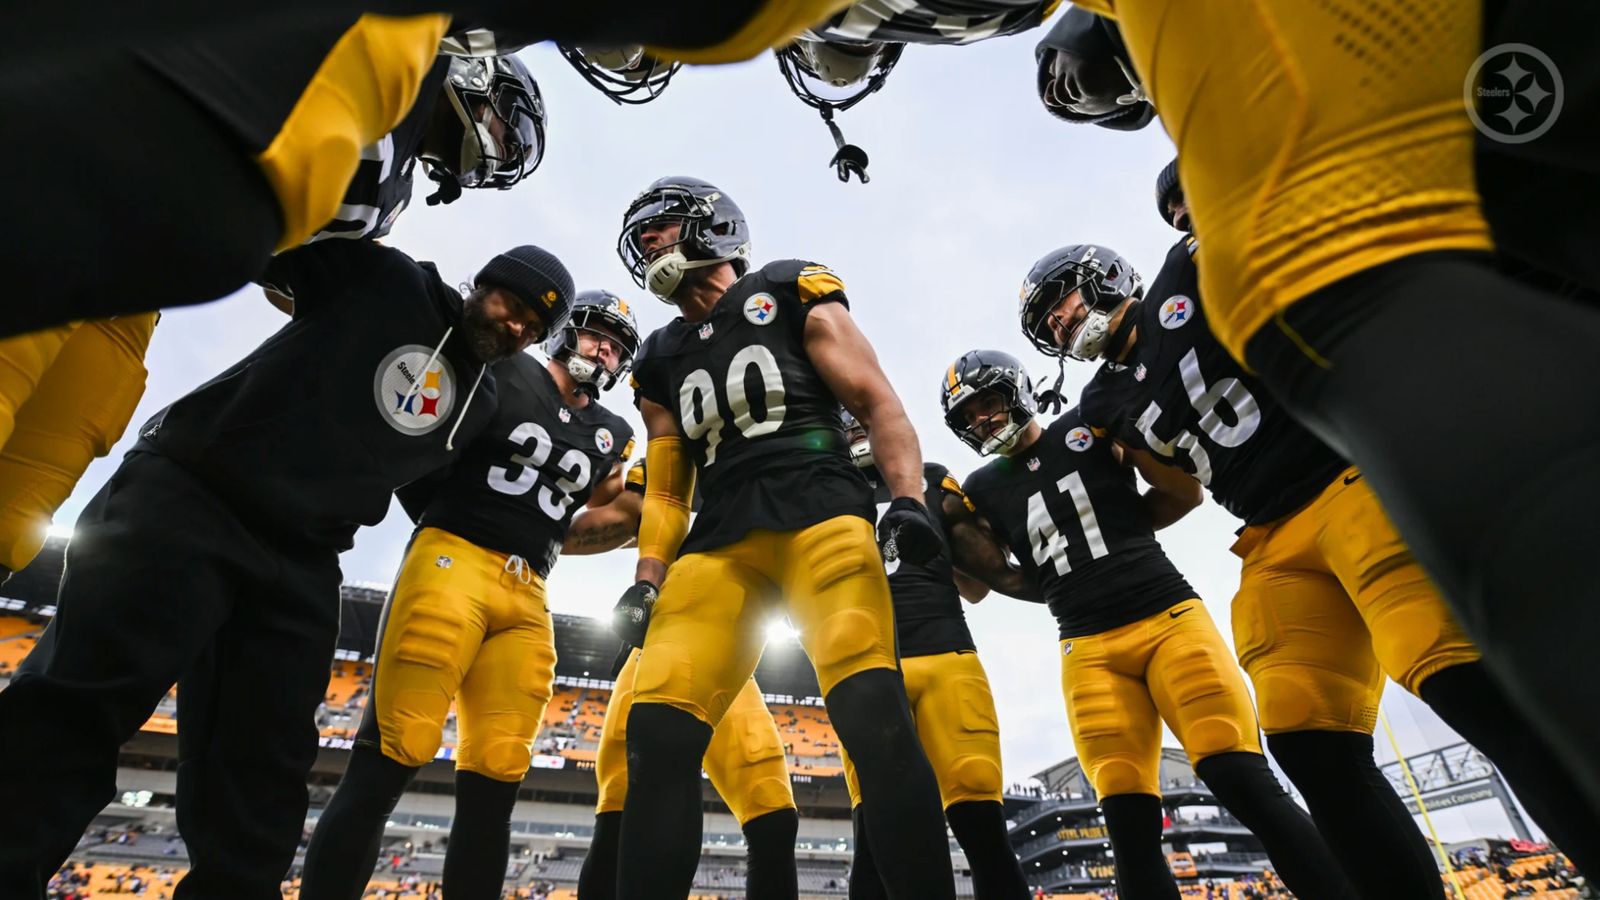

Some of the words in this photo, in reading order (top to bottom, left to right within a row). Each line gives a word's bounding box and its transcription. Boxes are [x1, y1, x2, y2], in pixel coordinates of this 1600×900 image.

[397, 361, 420, 390] Steeles
[678, 343, 787, 468] 90
[1134, 346, 1262, 488] 56
[486, 421, 592, 522] 33
[1027, 470, 1110, 577] 41
